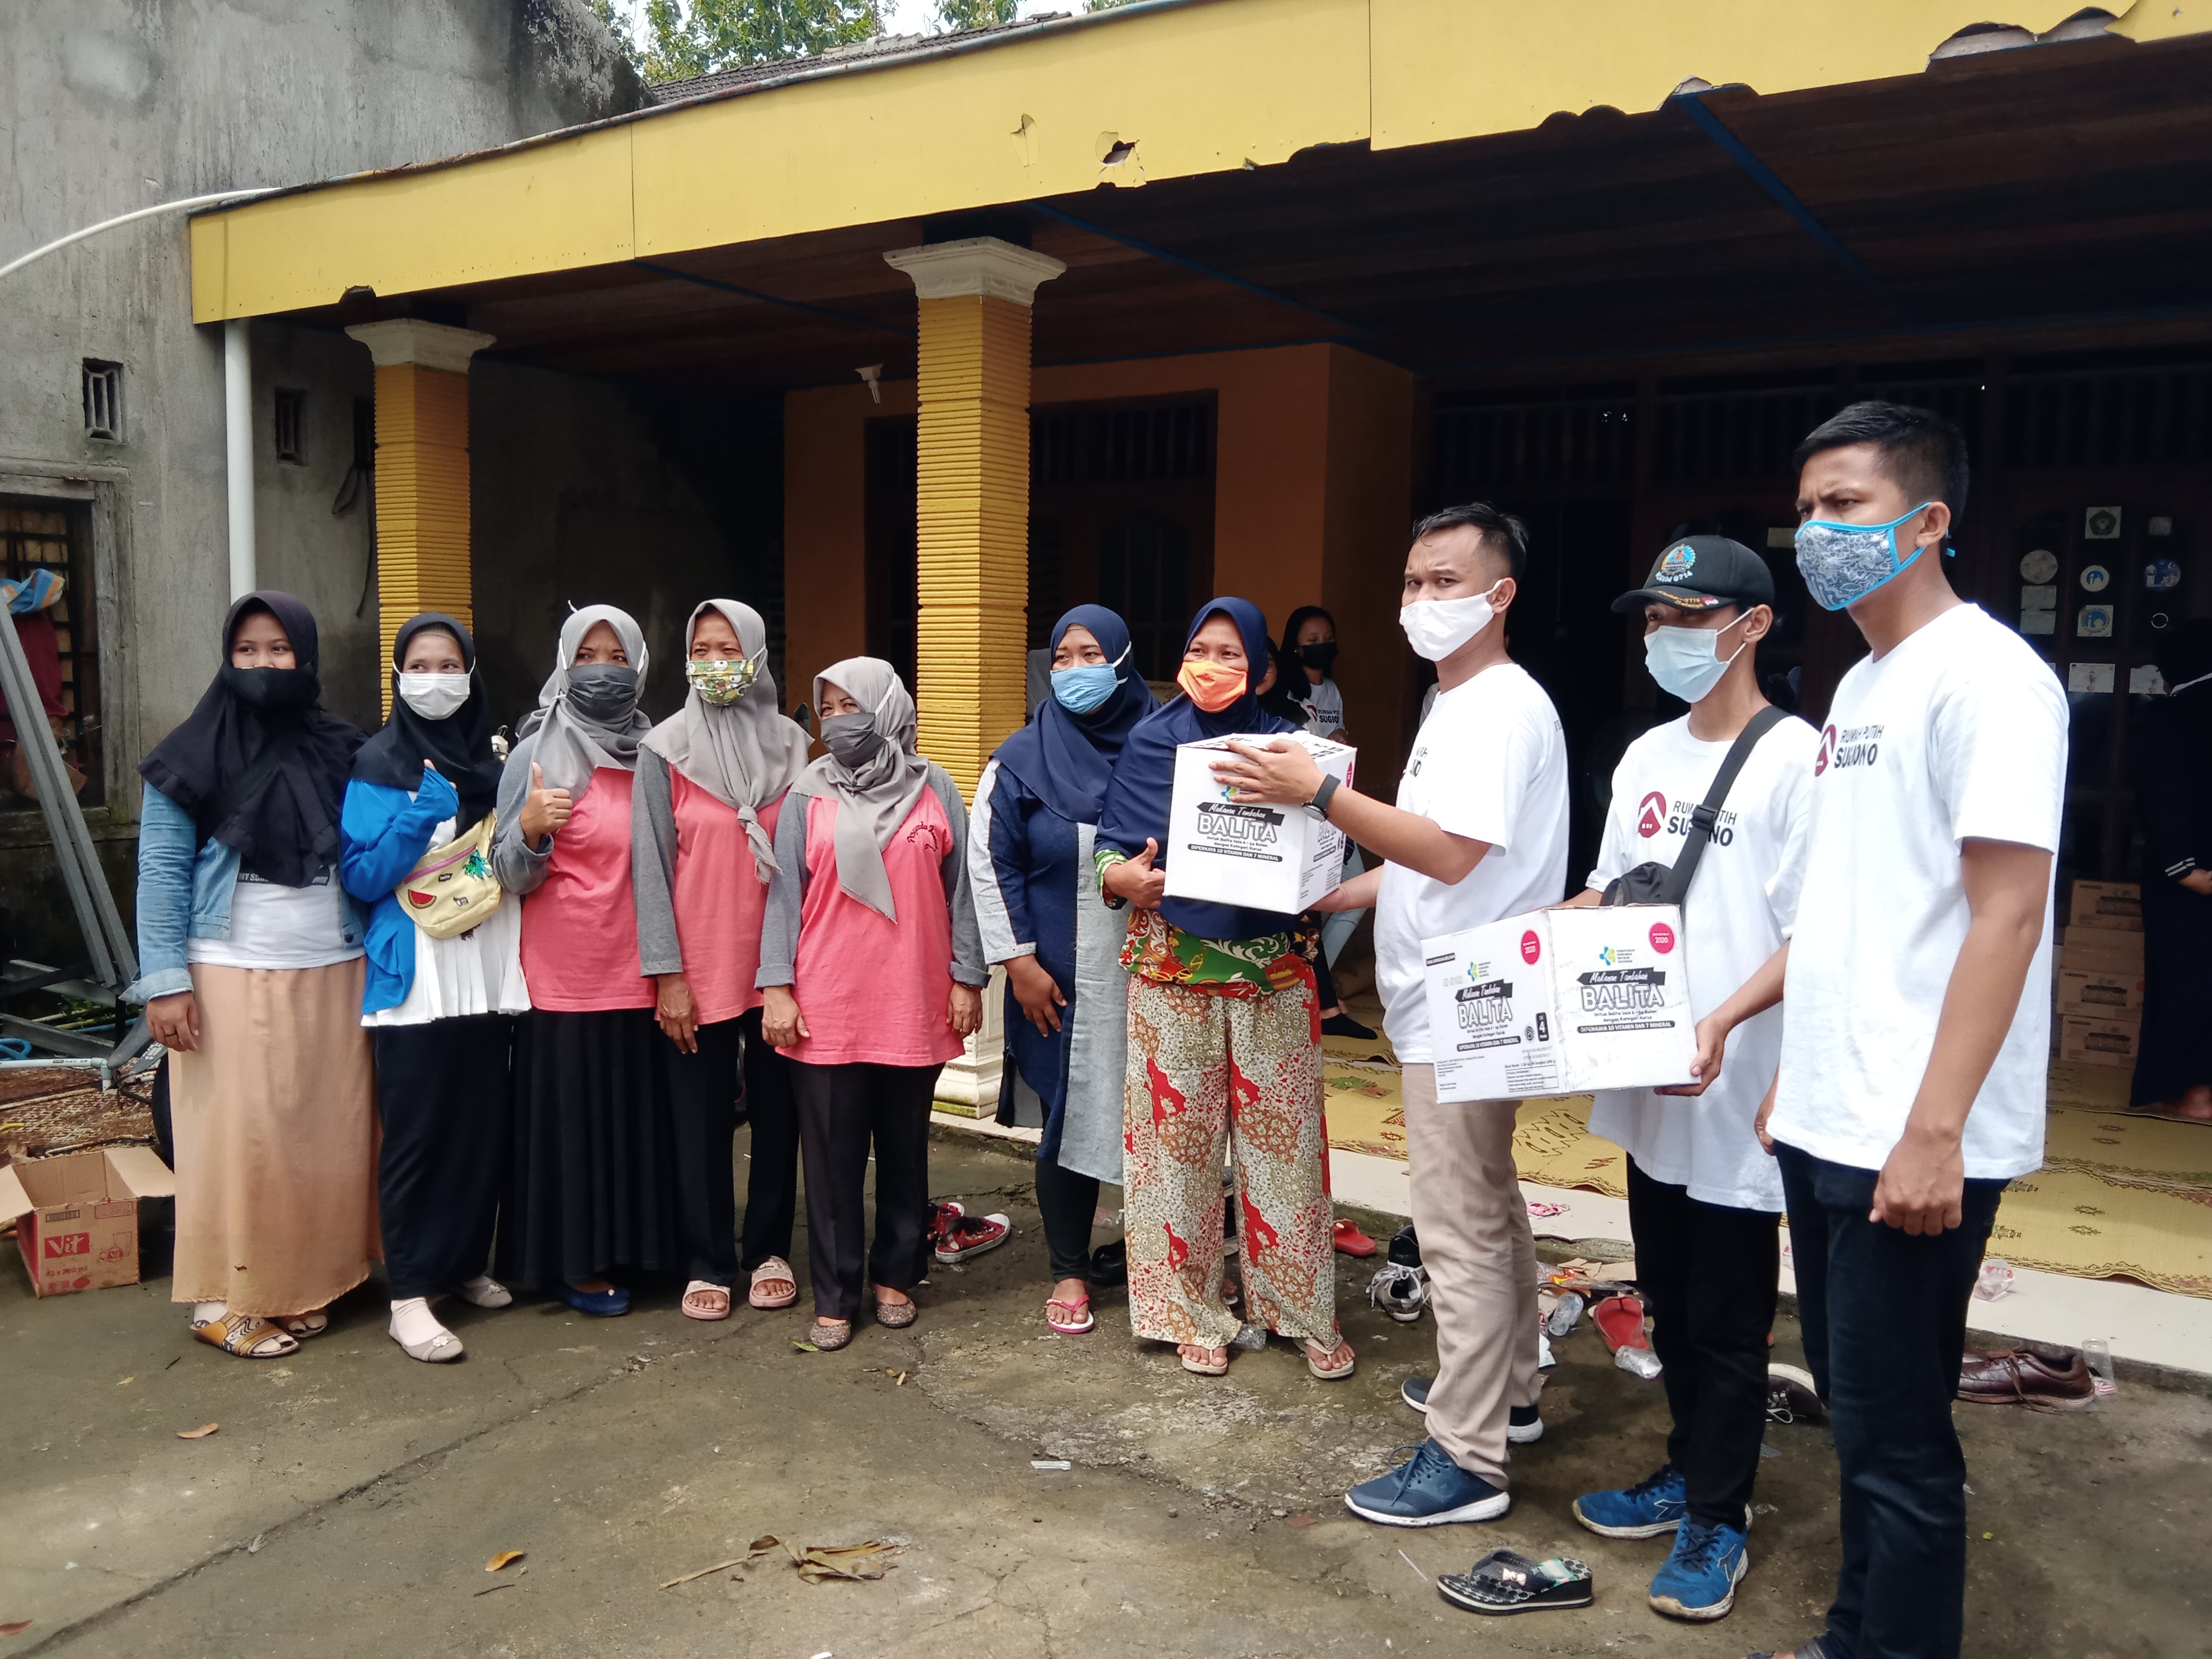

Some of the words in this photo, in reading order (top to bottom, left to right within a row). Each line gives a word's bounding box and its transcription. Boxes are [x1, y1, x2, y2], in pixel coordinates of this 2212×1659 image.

[1208, 803, 1235, 815] Makanan
[1238, 807, 1267, 818] Tambahan
[1673, 800, 1694, 815] RUM
[1197, 812, 1278, 843] BALITA
[1667, 816, 1733, 847] SUNO
[1191, 844, 1216, 853] DIPERKAYA
[1258, 853, 1279, 861] MINERAL
[1590, 972, 1618, 984] Makanan
[1620, 970, 1648, 982] Tambahan
[1580, 984, 1665, 1012] BALITA
[1457, 996, 1513, 1029] BALITA
[1539, 1021, 1545, 1034] 4
[48, 1234, 85, 1255] Vit
